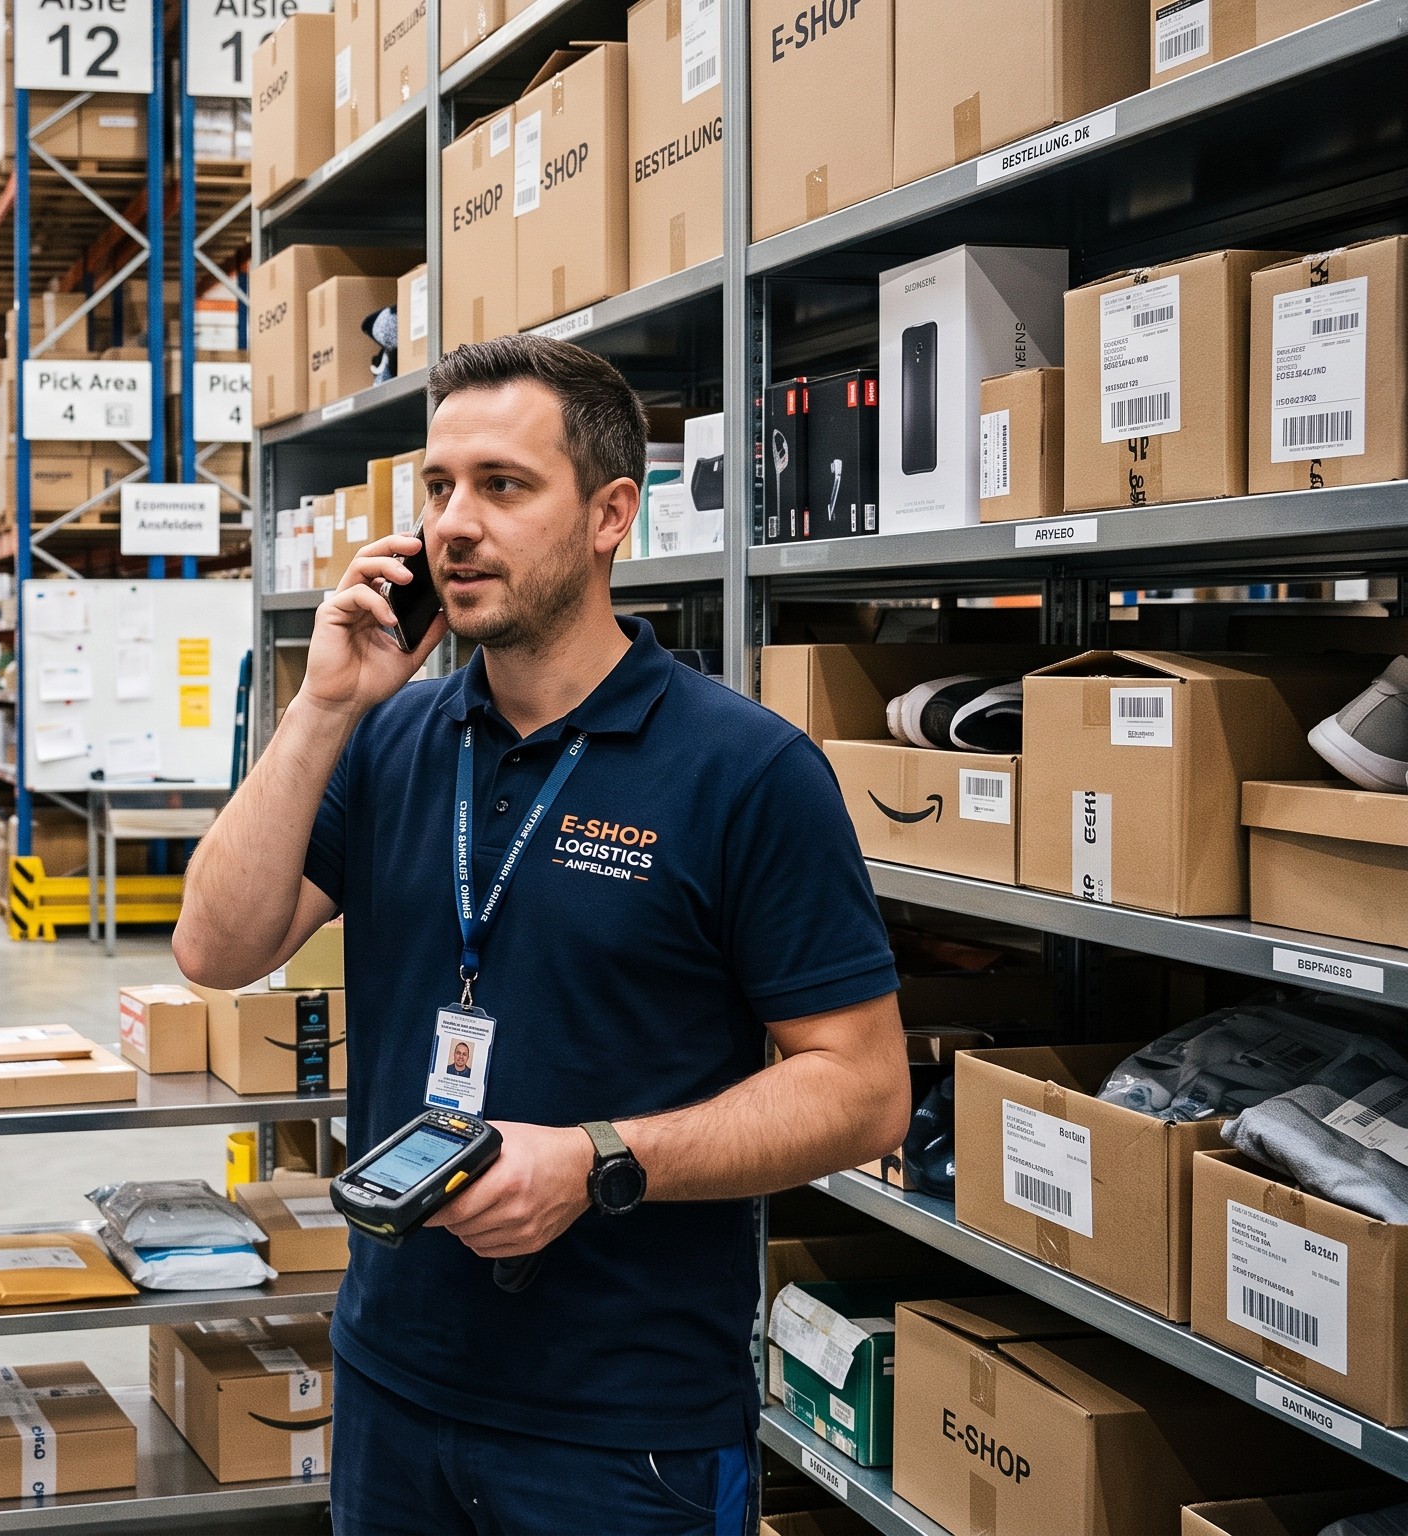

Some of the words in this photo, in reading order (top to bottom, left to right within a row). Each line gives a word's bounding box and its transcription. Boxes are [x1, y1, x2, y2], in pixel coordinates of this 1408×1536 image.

[48, 25, 119, 78] 12
[540, 142, 589, 191] -SHOP
[635, 116, 723, 183] BESTELLUNG
[1002, 133, 1072, 170] BESTELLUNG.
[453, 183, 503, 233] E-SHOP
[39, 373, 82, 391] Pick
[89, 374, 137, 391] Area
[62, 405, 75, 422] 4
[229, 406, 242, 424] 4
[560, 814, 658, 848] E-SHOP
[554, 836, 653, 869] LOGISTICS
[564, 858, 632, 881] ANFELDEN
[942, 1407, 1031, 1485] E-SHOP
